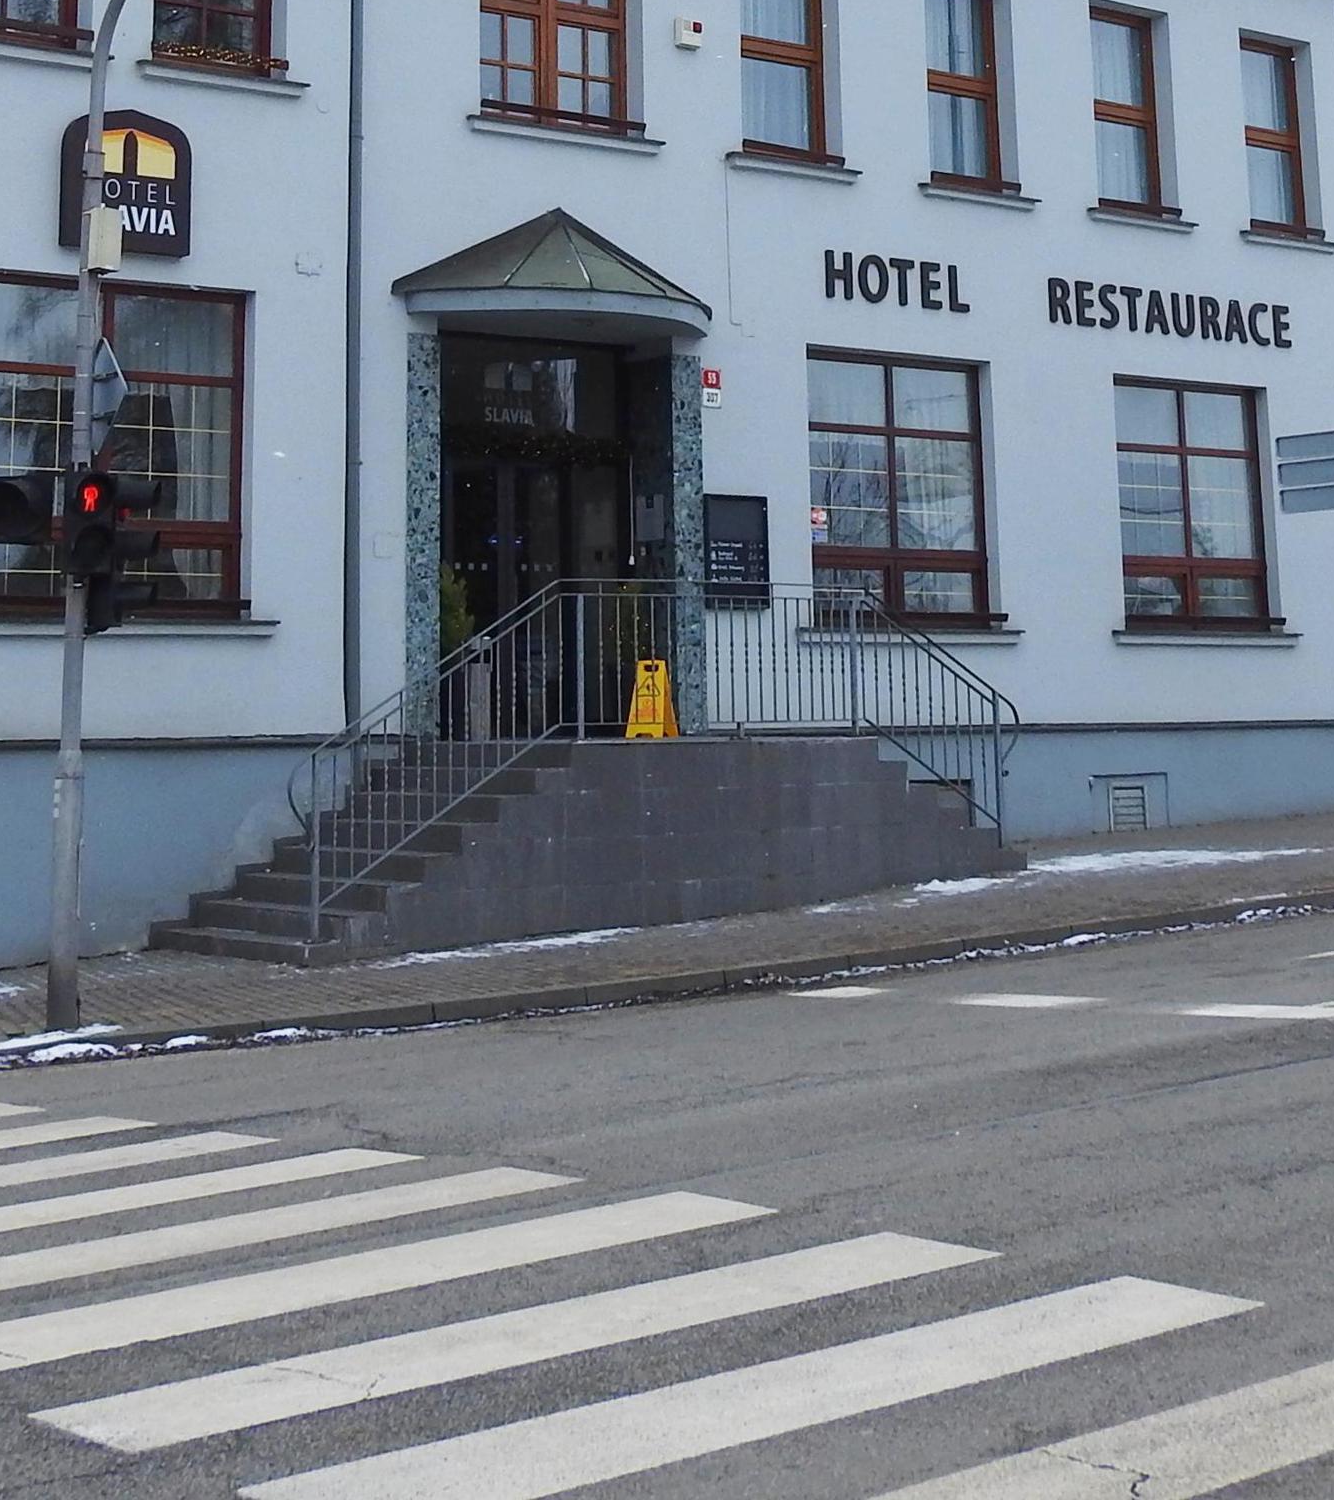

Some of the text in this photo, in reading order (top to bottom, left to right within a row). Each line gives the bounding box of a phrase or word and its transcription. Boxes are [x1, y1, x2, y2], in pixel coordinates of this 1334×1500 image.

[105, 179, 176, 205] OTEL
[117, 204, 176, 236] AVIA
[823, 249, 971, 314] HOTEL
[1047, 276, 1293, 349] RESTAURACE
[484, 406, 535, 427] SLAVIA
